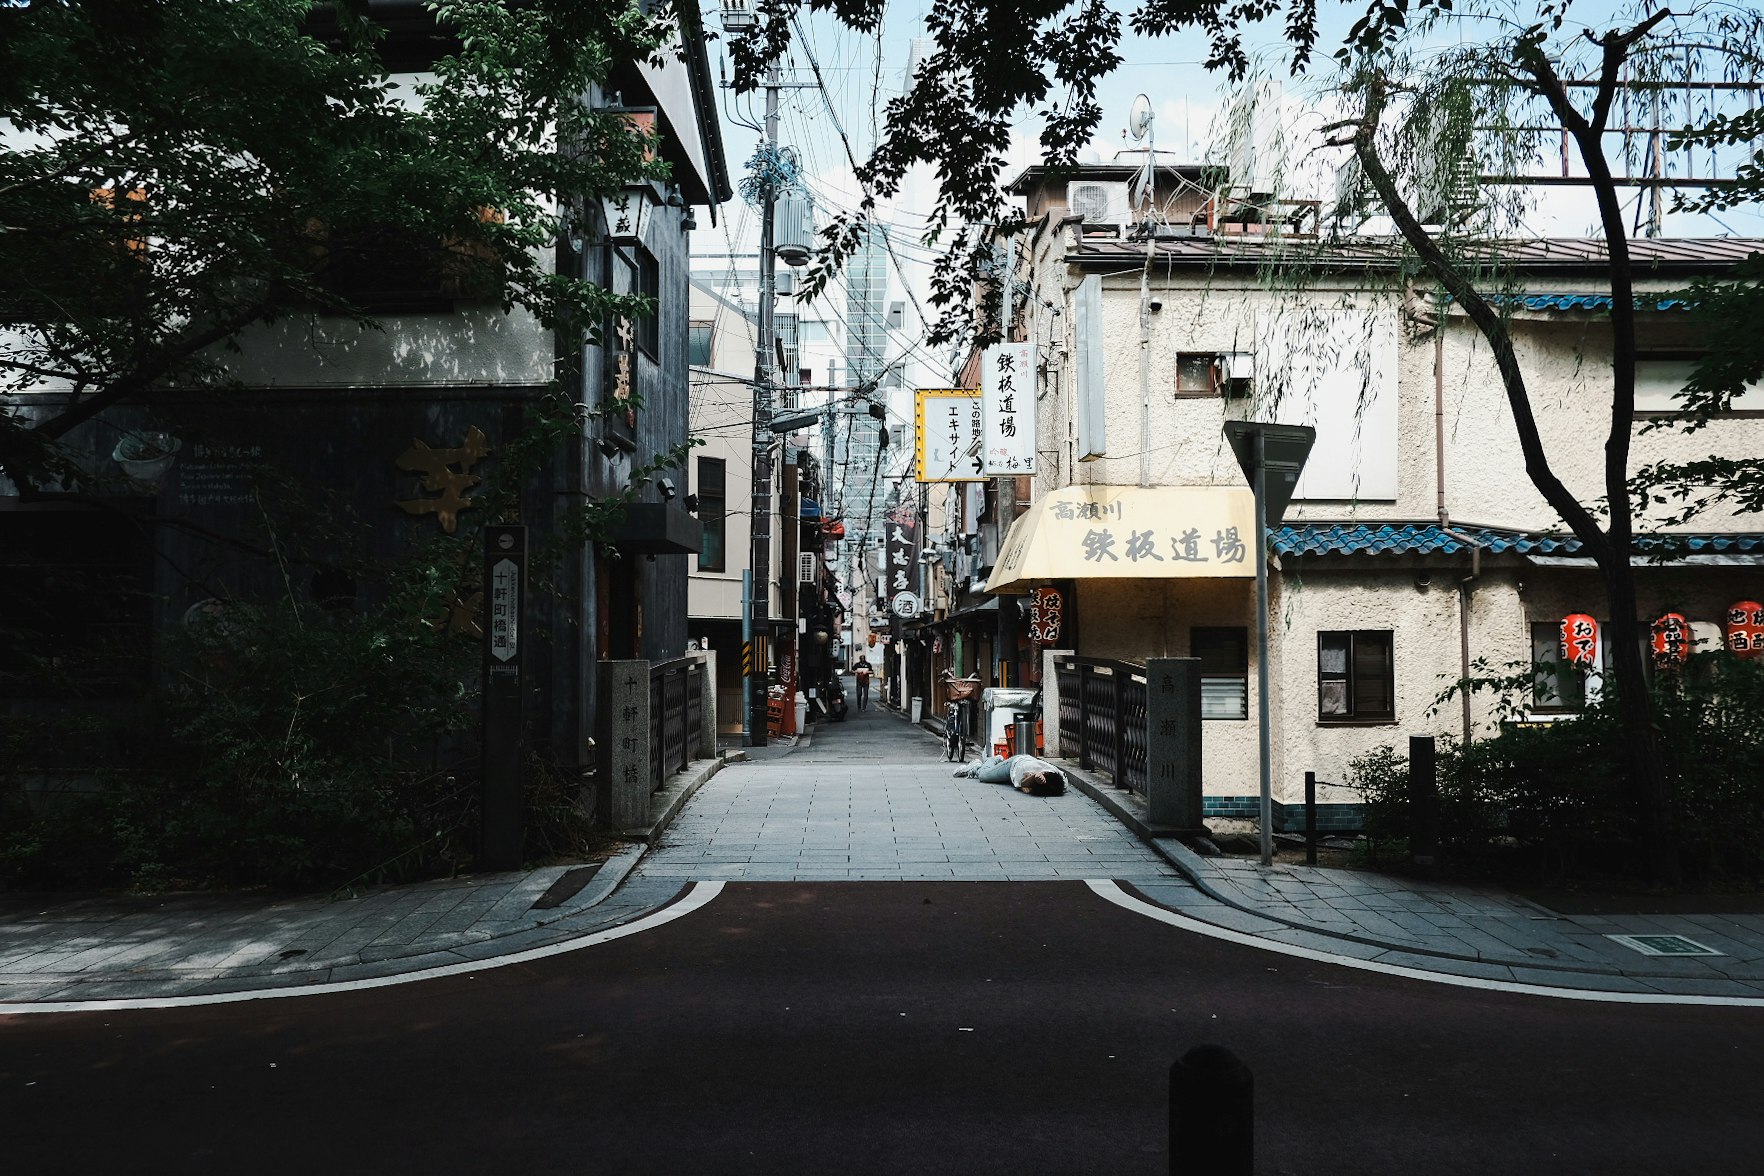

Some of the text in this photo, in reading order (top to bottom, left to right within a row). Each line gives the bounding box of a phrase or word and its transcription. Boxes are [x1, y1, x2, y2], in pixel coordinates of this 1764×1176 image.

[996, 352, 1017, 438] 鉄板道場
[948, 406, 960, 472] エキサイト
[972, 402, 982, 444] この路地
[1049, 501, 1122, 525] 高瀬川
[1081, 526, 1246, 569] 鉄板道場
[494, 571, 508, 649] 十軒町橋通
[899, 599, 914, 614] 酒
[1043, 593, 1062, 641] 焼そば
[1572, 620, 1595, 669] おでん
[622, 676, 639, 784] 十軒町橋
[1160, 674, 1177, 780] 高瀬川
